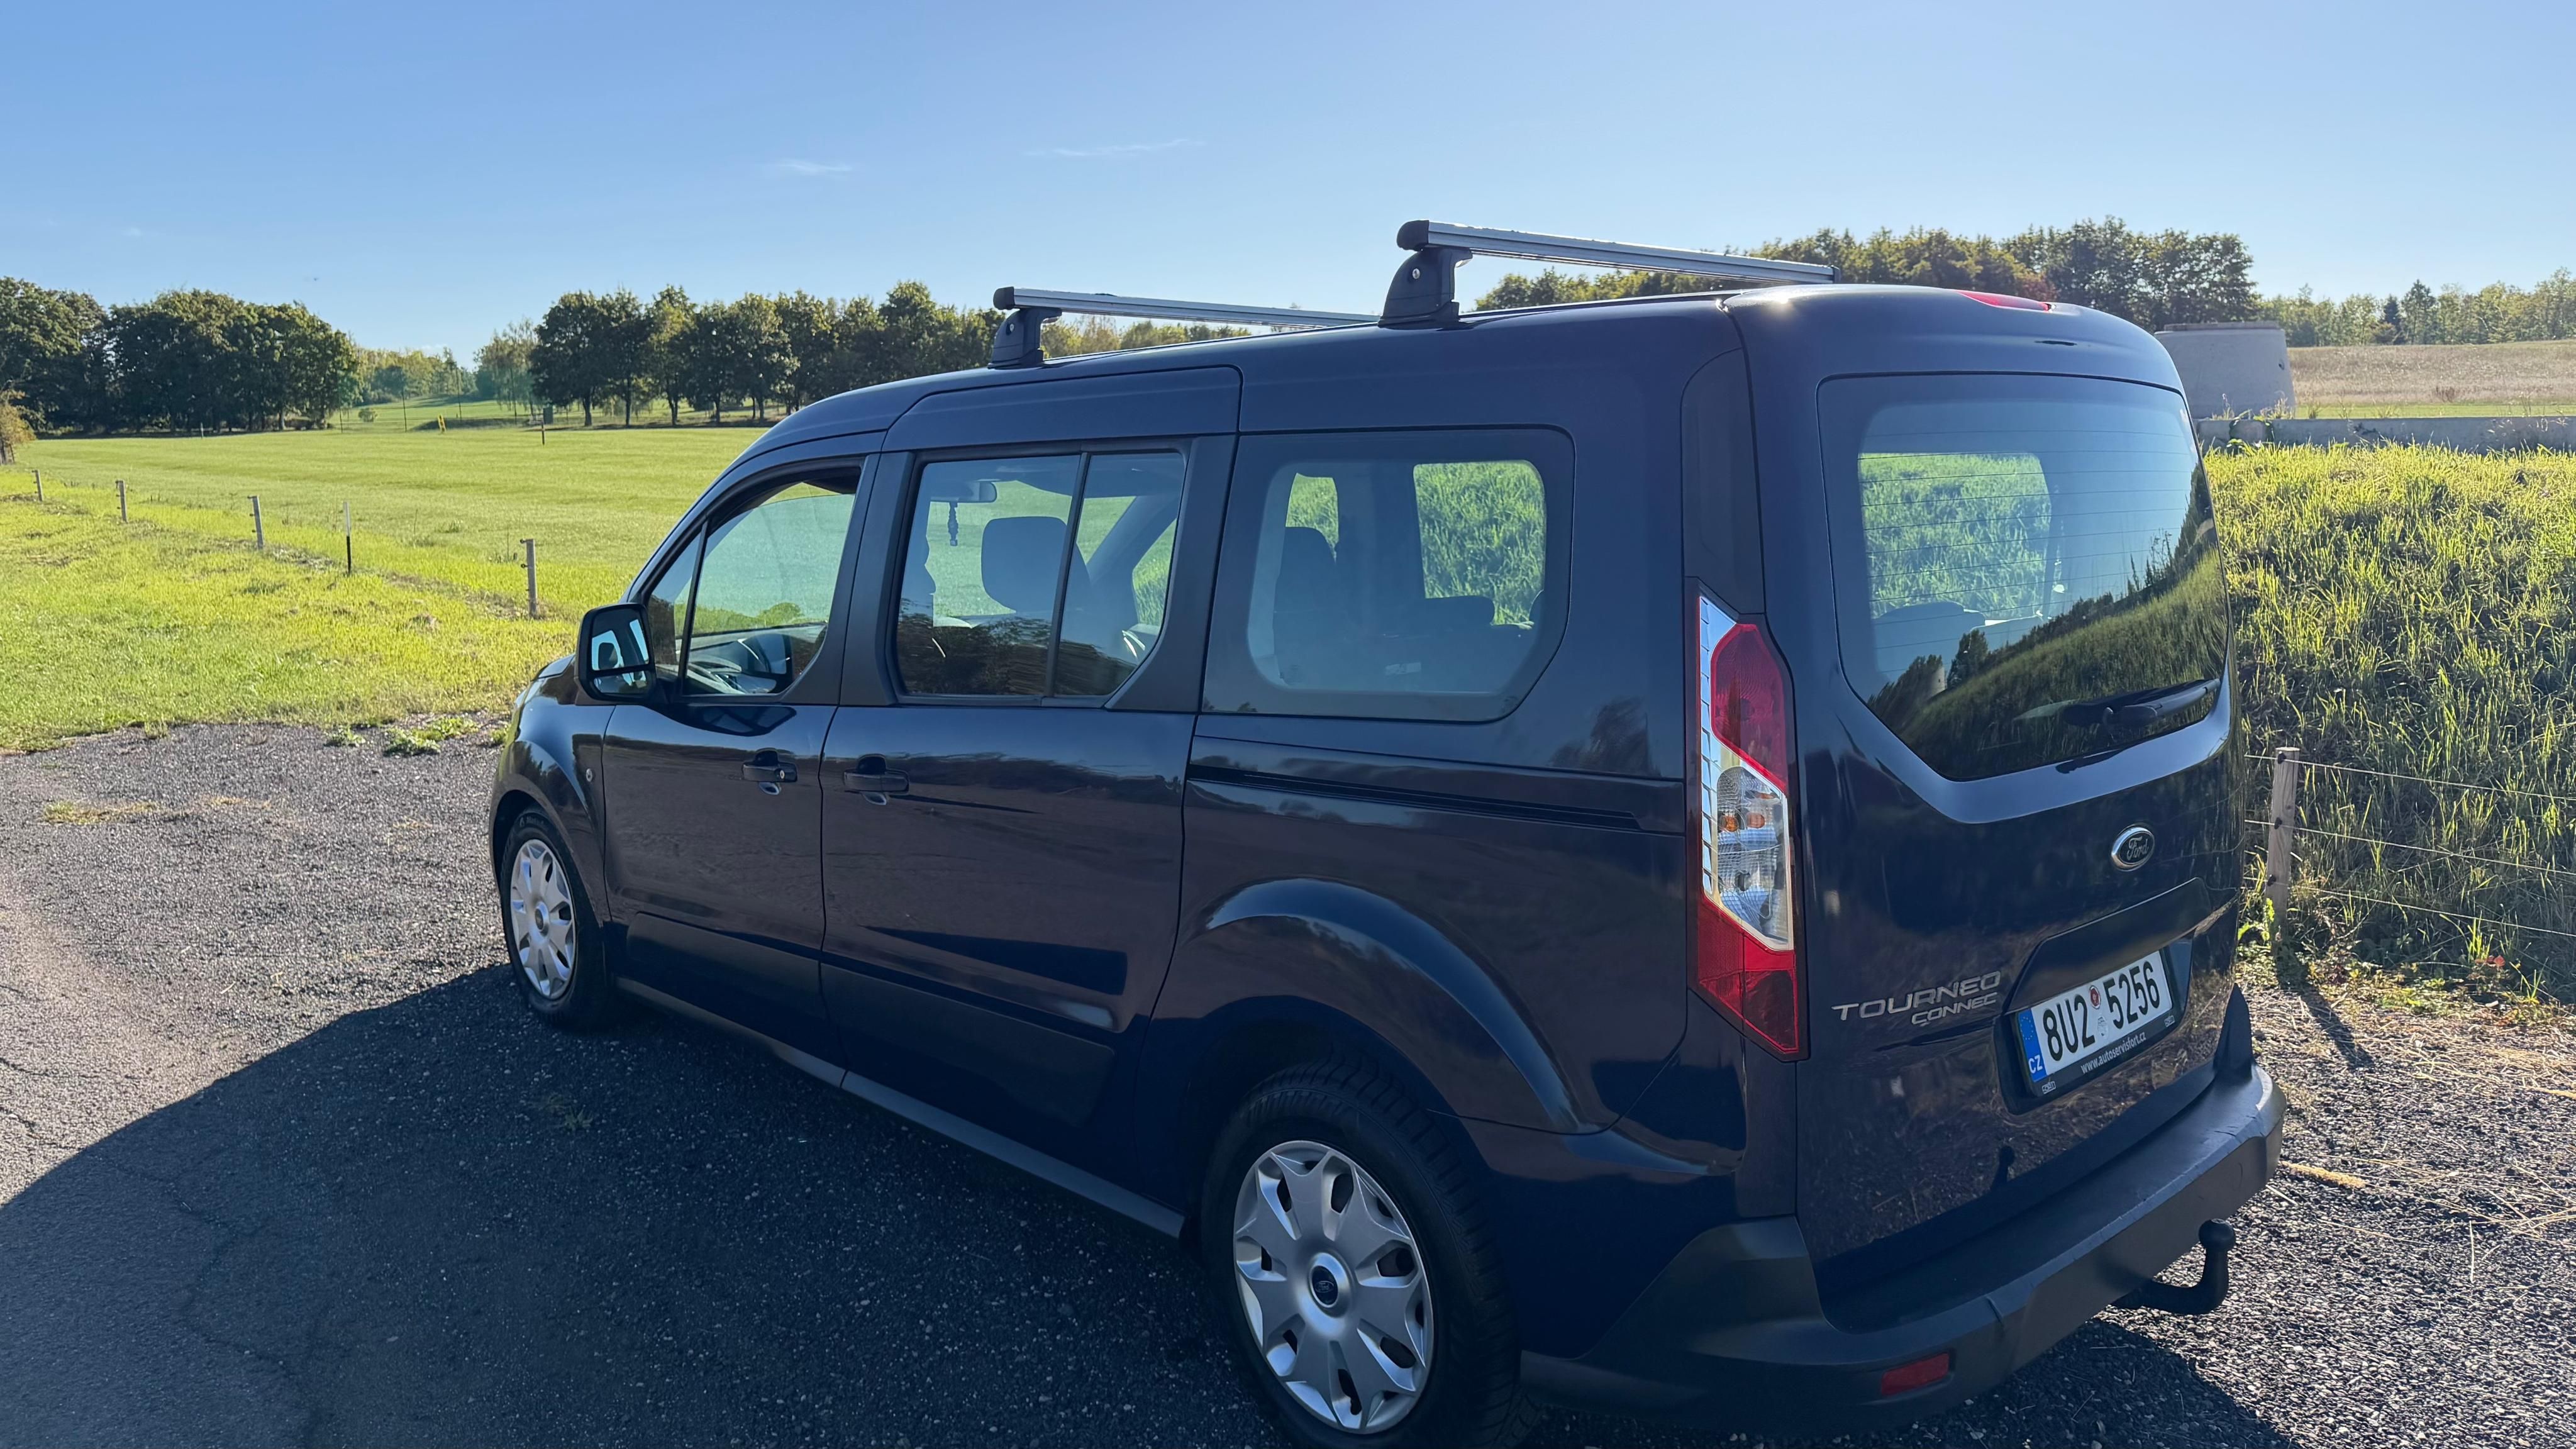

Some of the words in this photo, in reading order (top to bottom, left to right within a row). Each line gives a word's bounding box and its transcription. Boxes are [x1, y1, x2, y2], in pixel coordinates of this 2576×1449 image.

[2126, 836, 2150, 861] Ford
[1831, 970, 2001, 1021] TOURNEO
[2043, 993, 2096, 1062] 8U2
[2102, 960, 2160, 1030] 5256
[2028, 1054, 2043, 1074] CZ
[2080, 1031, 2146, 1074] www.autoservisfort.cz
